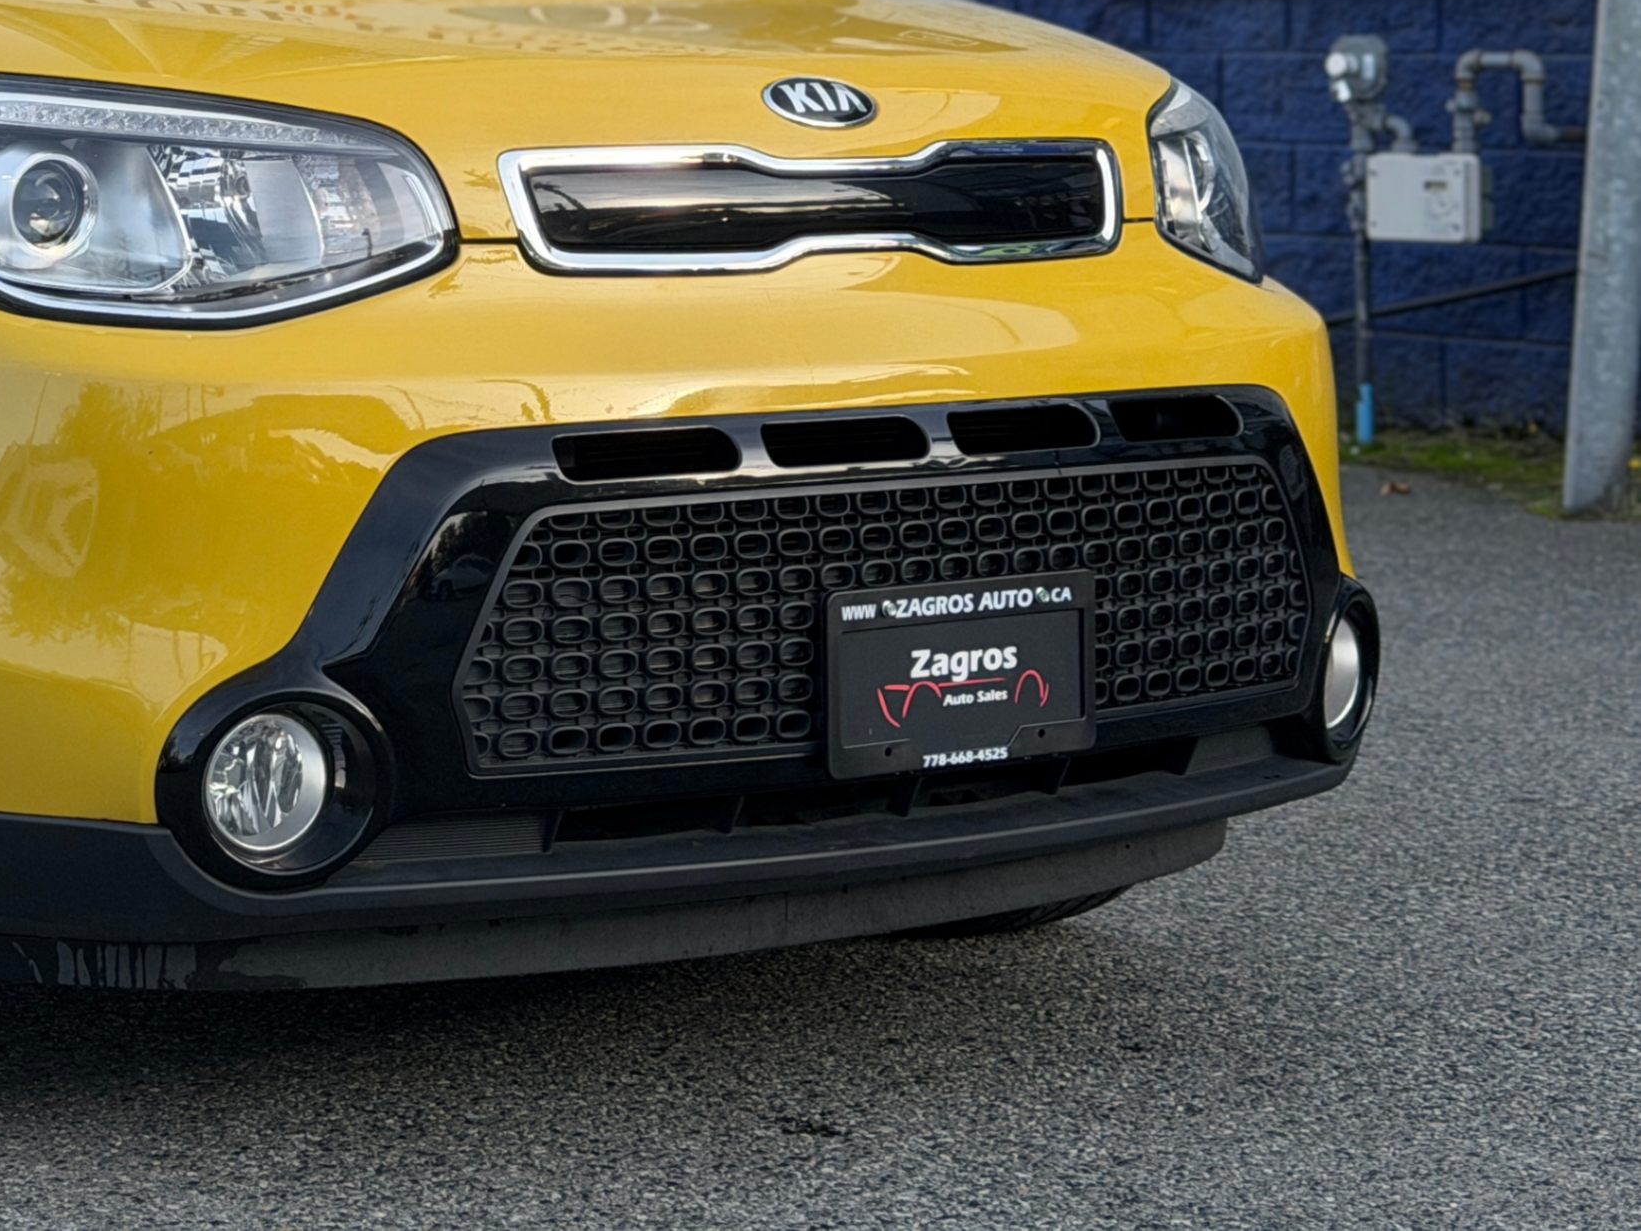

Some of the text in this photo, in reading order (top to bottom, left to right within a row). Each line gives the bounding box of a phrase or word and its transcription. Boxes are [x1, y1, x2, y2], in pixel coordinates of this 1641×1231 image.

[777, 82, 867, 113] KIA
[841, 586, 1072, 622] WWW ZAGROS AUTO CA
[910, 646, 1018, 682] Zagros
[943, 689, 1008, 707] Auto Sales
[922, 747, 1008, 769] 778-668-4525
